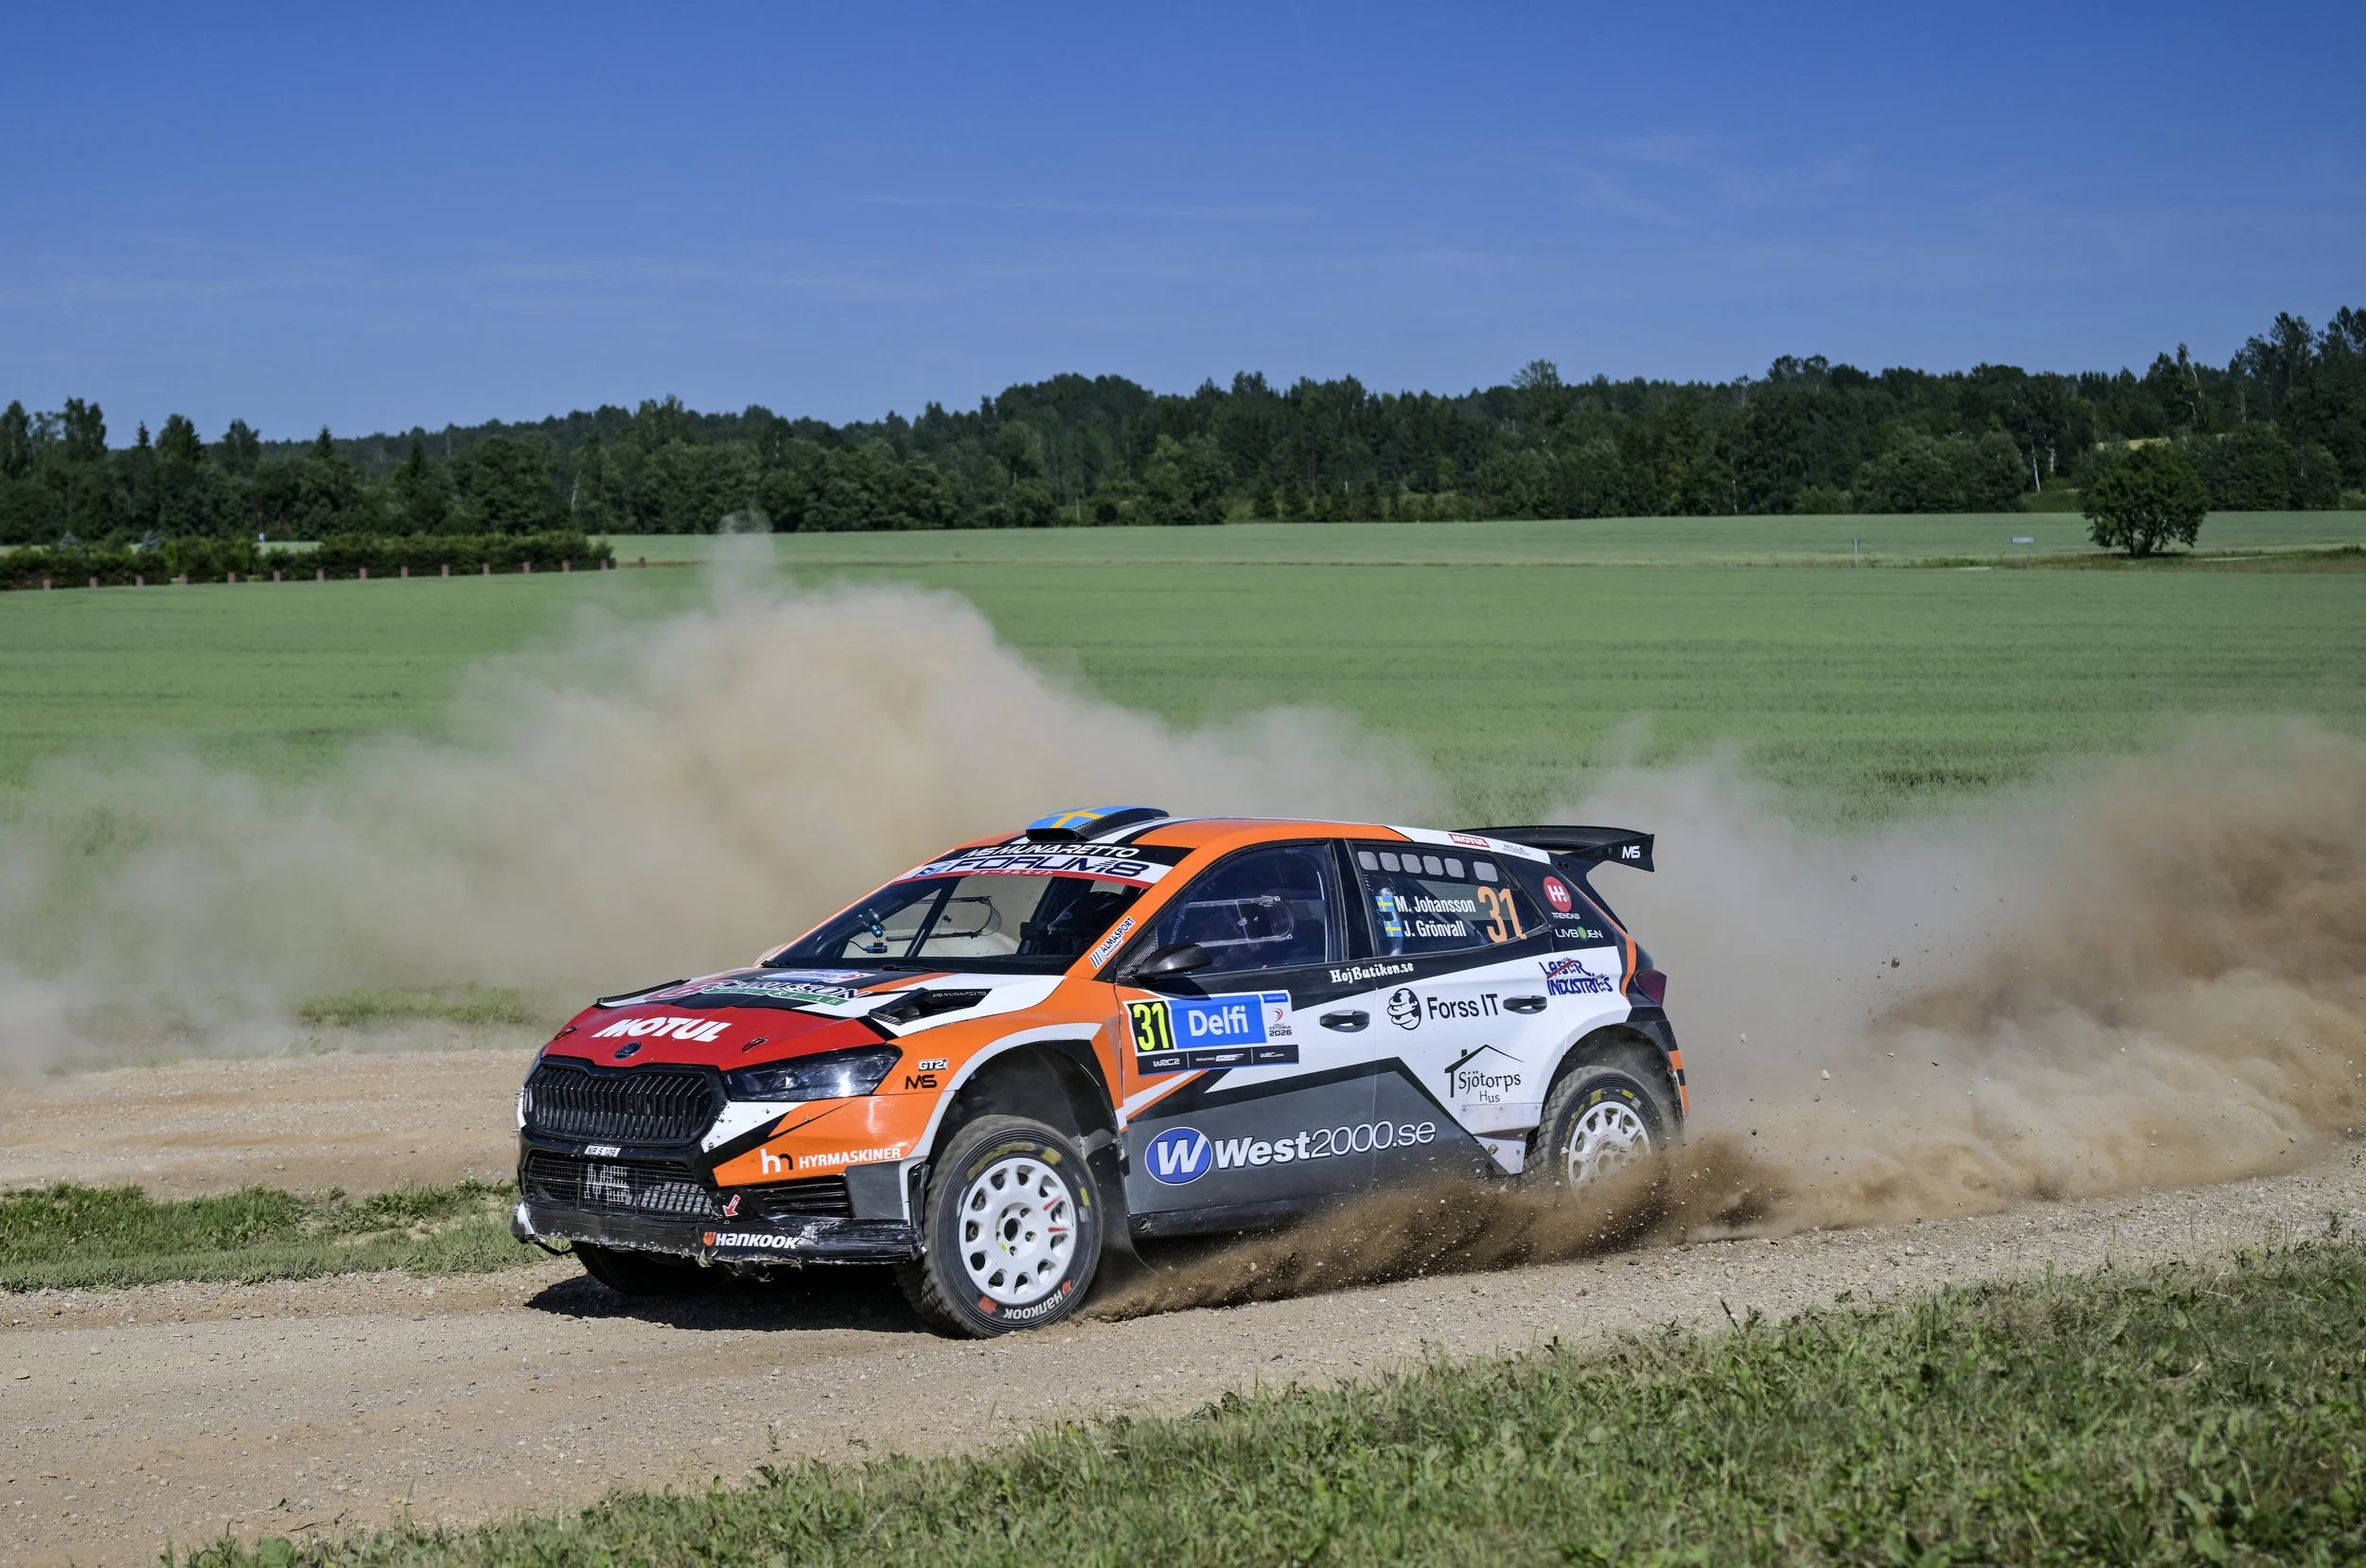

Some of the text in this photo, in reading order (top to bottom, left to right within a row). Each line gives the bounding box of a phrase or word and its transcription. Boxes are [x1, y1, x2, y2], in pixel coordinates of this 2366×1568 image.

[993, 844, 1139, 858] MUNARETTO
[1451, 835, 1488, 847] MOTUL
[1394, 895, 1476, 913] M. Johansson
[1476, 885, 1527, 943] 31
[1100, 917, 1135, 953] ALMASPORT
[1404, 919, 1467, 938] J. Grönvall
[1426, 994, 1498, 1020] Forss IT
[591, 1017, 733, 1042] MOTUL
[1132, 1002, 1170, 1051] 31
[1188, 1005, 1249, 1037] Delfi
[918, 1058, 948, 1071] GT2i
[1153, 1058, 1181, 1067] WRC2
[905, 1074, 938, 1090] MS
[1457, 1070, 1522, 1095] Sjötorps
[1478, 1089, 1501, 1104] Hus
[1214, 1120, 1437, 1170] West2000.se
[799, 1147, 901, 1170] HYRMASKINER
